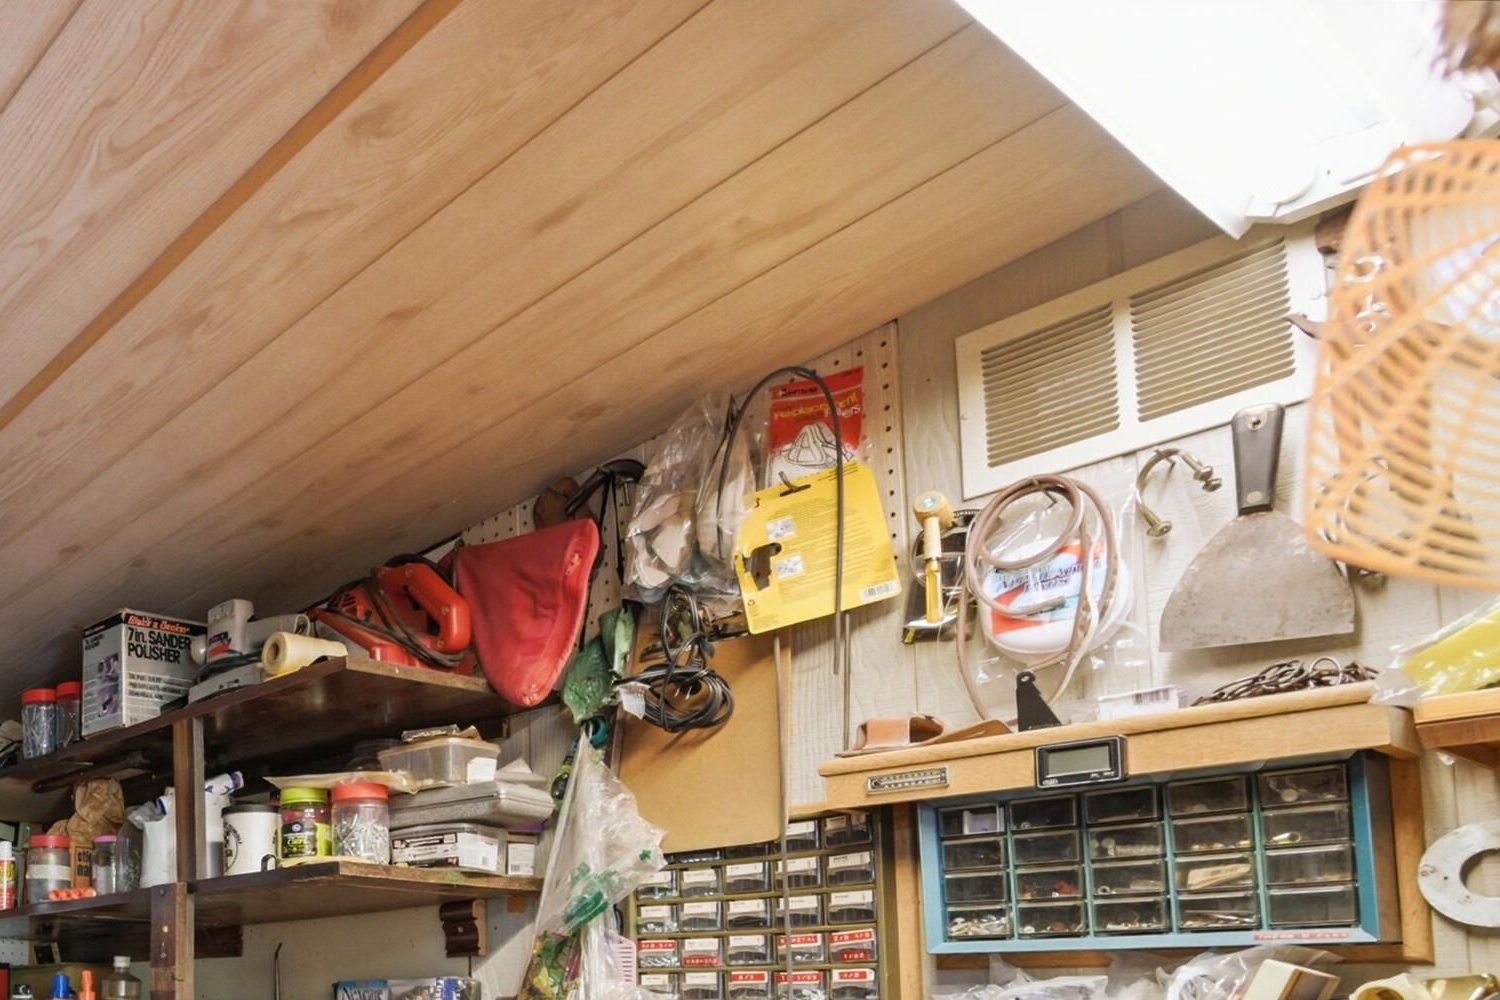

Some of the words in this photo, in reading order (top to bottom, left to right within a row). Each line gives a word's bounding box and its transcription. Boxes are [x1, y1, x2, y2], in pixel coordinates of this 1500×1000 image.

[128, 627, 134, 641] 7
[148, 632, 192, 650] SANDER
[128, 642, 181, 665] POLISHER
